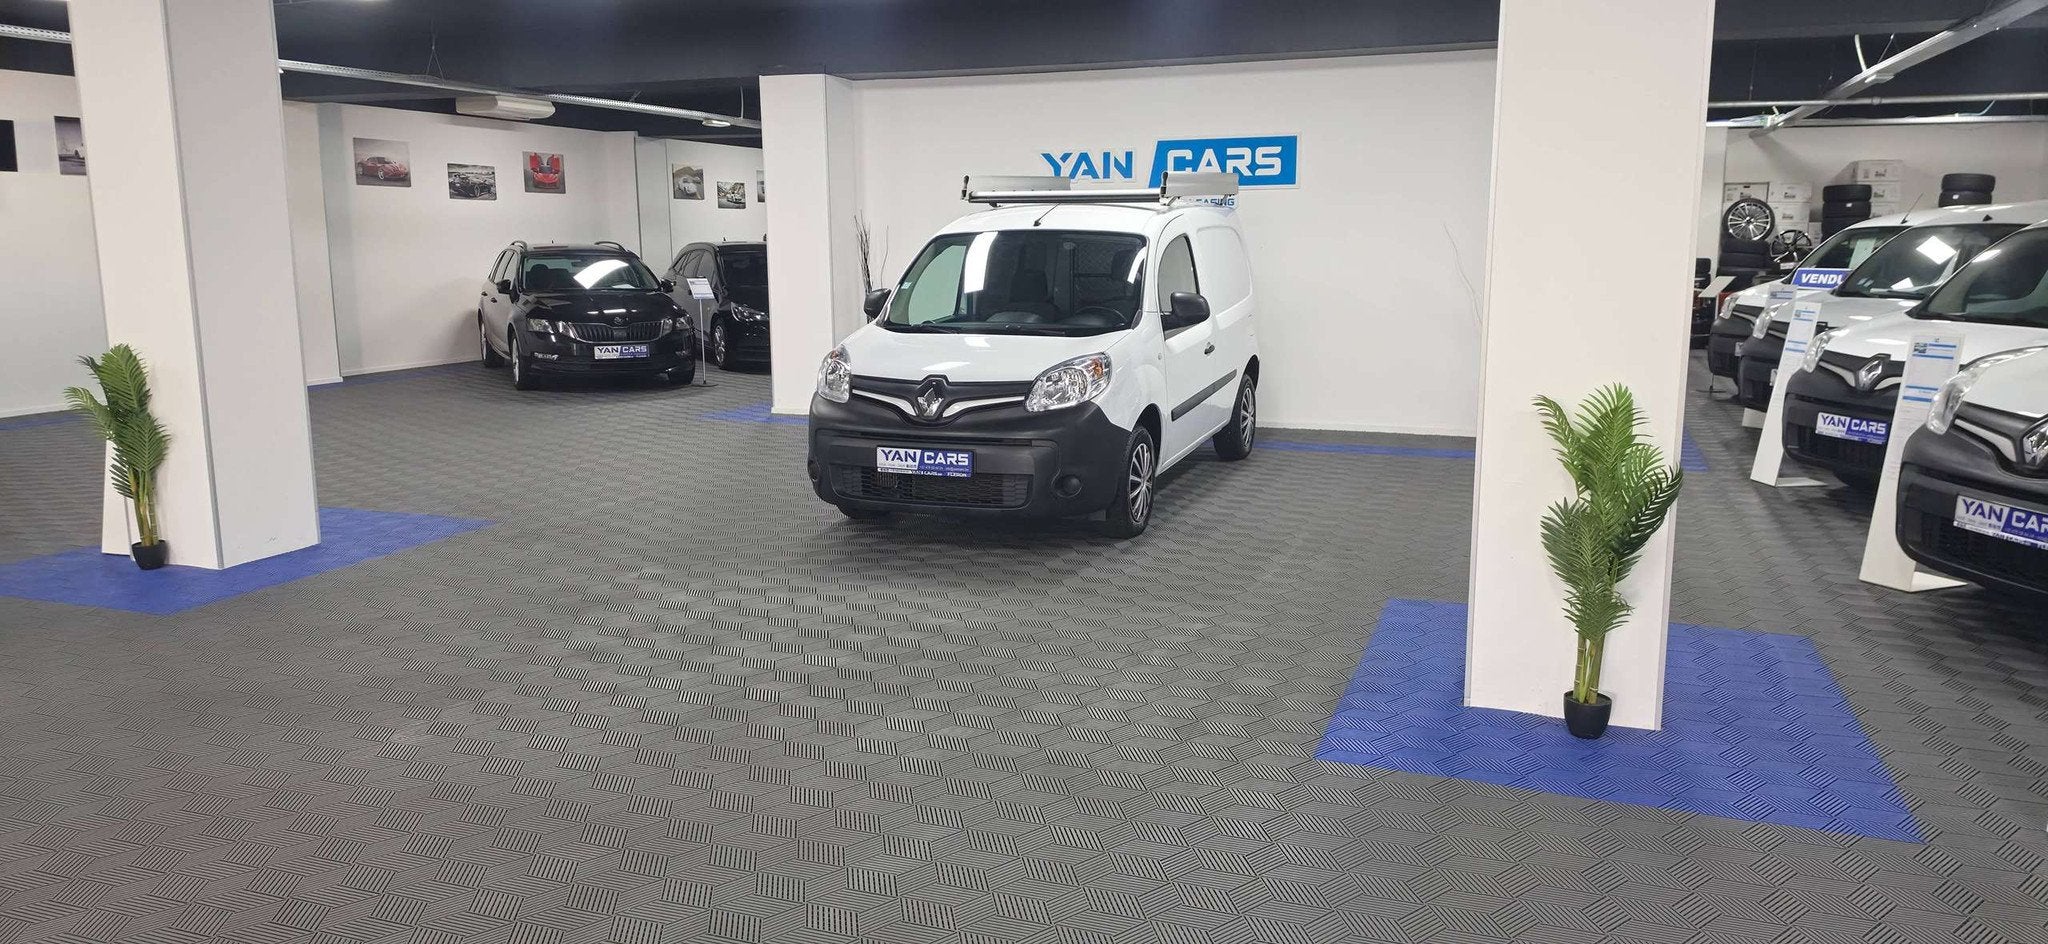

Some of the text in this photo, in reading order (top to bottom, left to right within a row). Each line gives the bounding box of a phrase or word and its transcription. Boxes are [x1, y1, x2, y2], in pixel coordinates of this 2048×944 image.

[1041, 146, 1282, 180] YAN CARS
[622, 345, 647, 353] CARS
[1821, 414, 1847, 428] YAN
[1851, 419, 1886, 434] CARS
[880, 449, 917, 463] YAN
[924, 452, 969, 466] CARS
[1962, 499, 2004, 523] YAN
